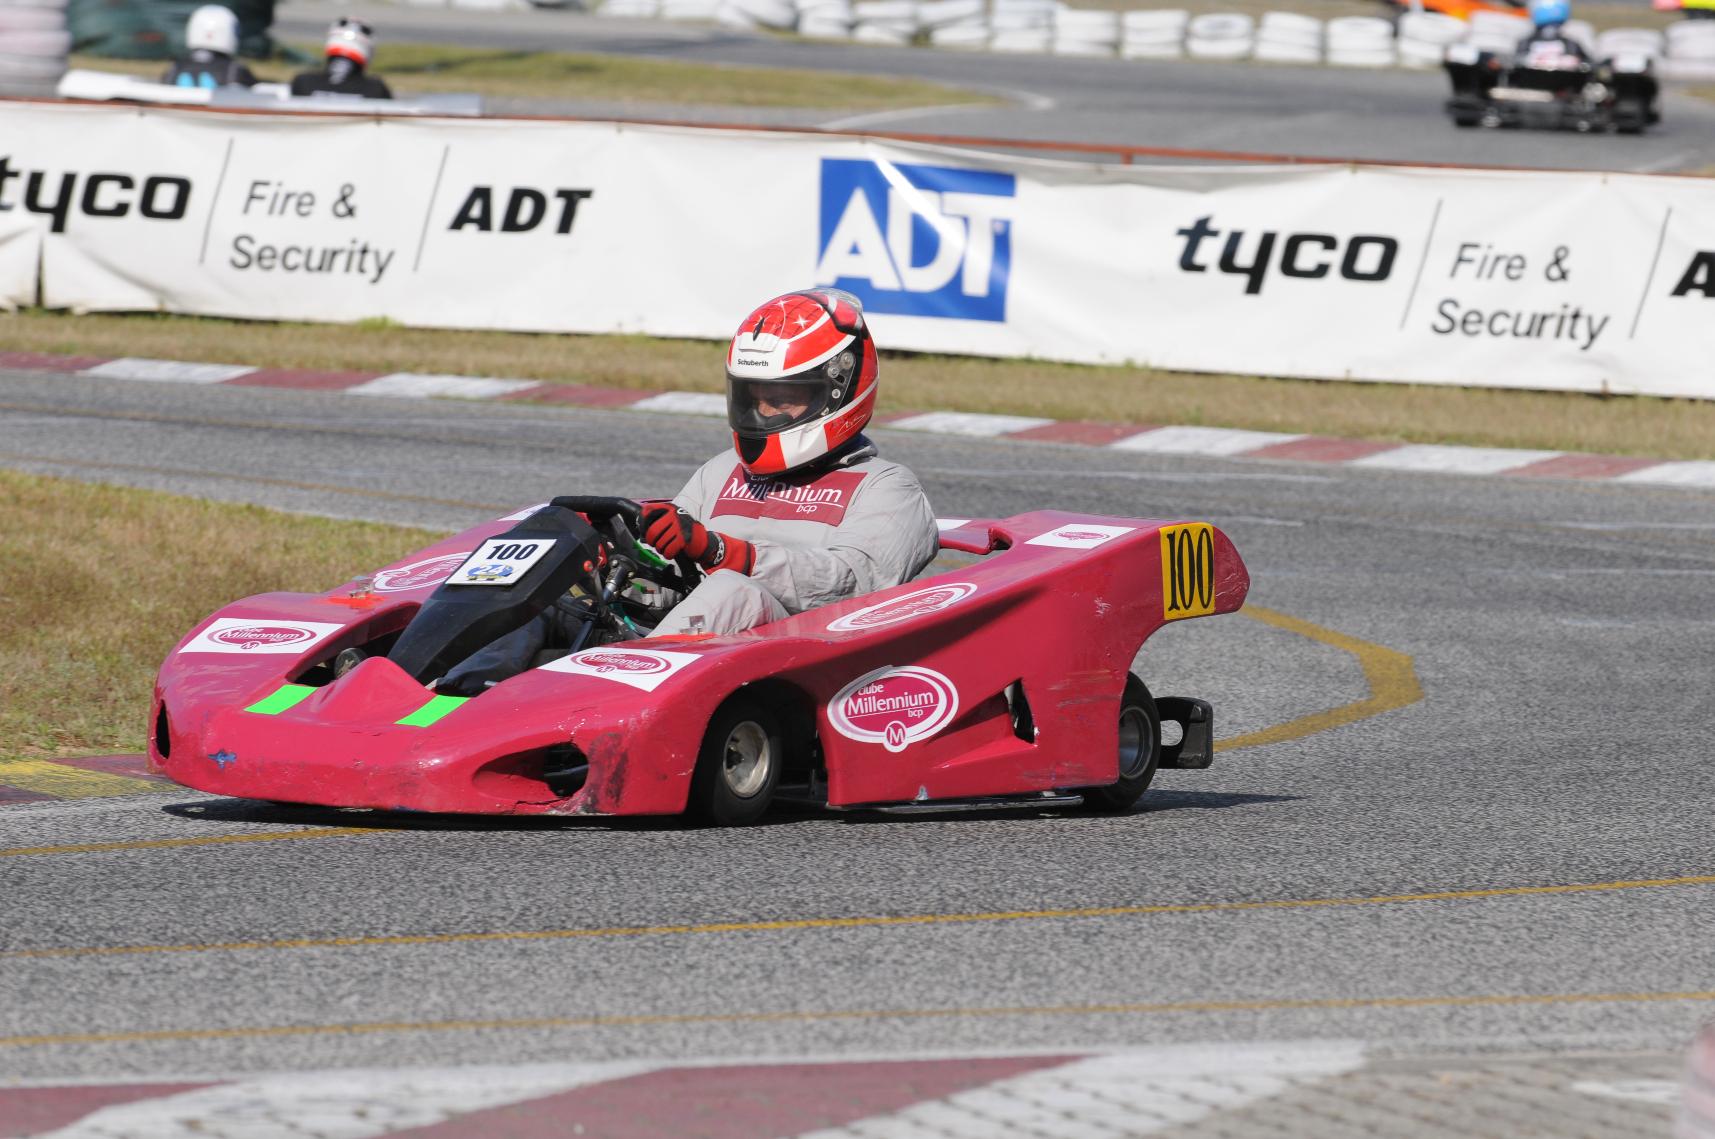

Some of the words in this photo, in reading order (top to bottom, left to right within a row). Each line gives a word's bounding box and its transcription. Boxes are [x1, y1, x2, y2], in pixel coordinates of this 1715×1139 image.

[243, 180, 315, 218] Fire
[332, 183, 357, 219] &
[449, 186, 593, 234] ADT
[229, 234, 395, 284] Security
[816, 187, 1016, 297] ADT
[1177, 216, 1399, 295] tyco
[1450, 242, 1527, 281] Fire
[1545, 245, 1570, 283] &
[1431, 298, 1610, 351] Security
[737, 358, 769, 367] Schuberth
[796, 504, 817, 514] bcp
[486, 543, 539, 561] 100
[1166, 528, 1214, 612] 100
[847, 691, 934, 716] Millennium
[907, 708, 924, 719] bcp
[889, 725, 905, 744] M
